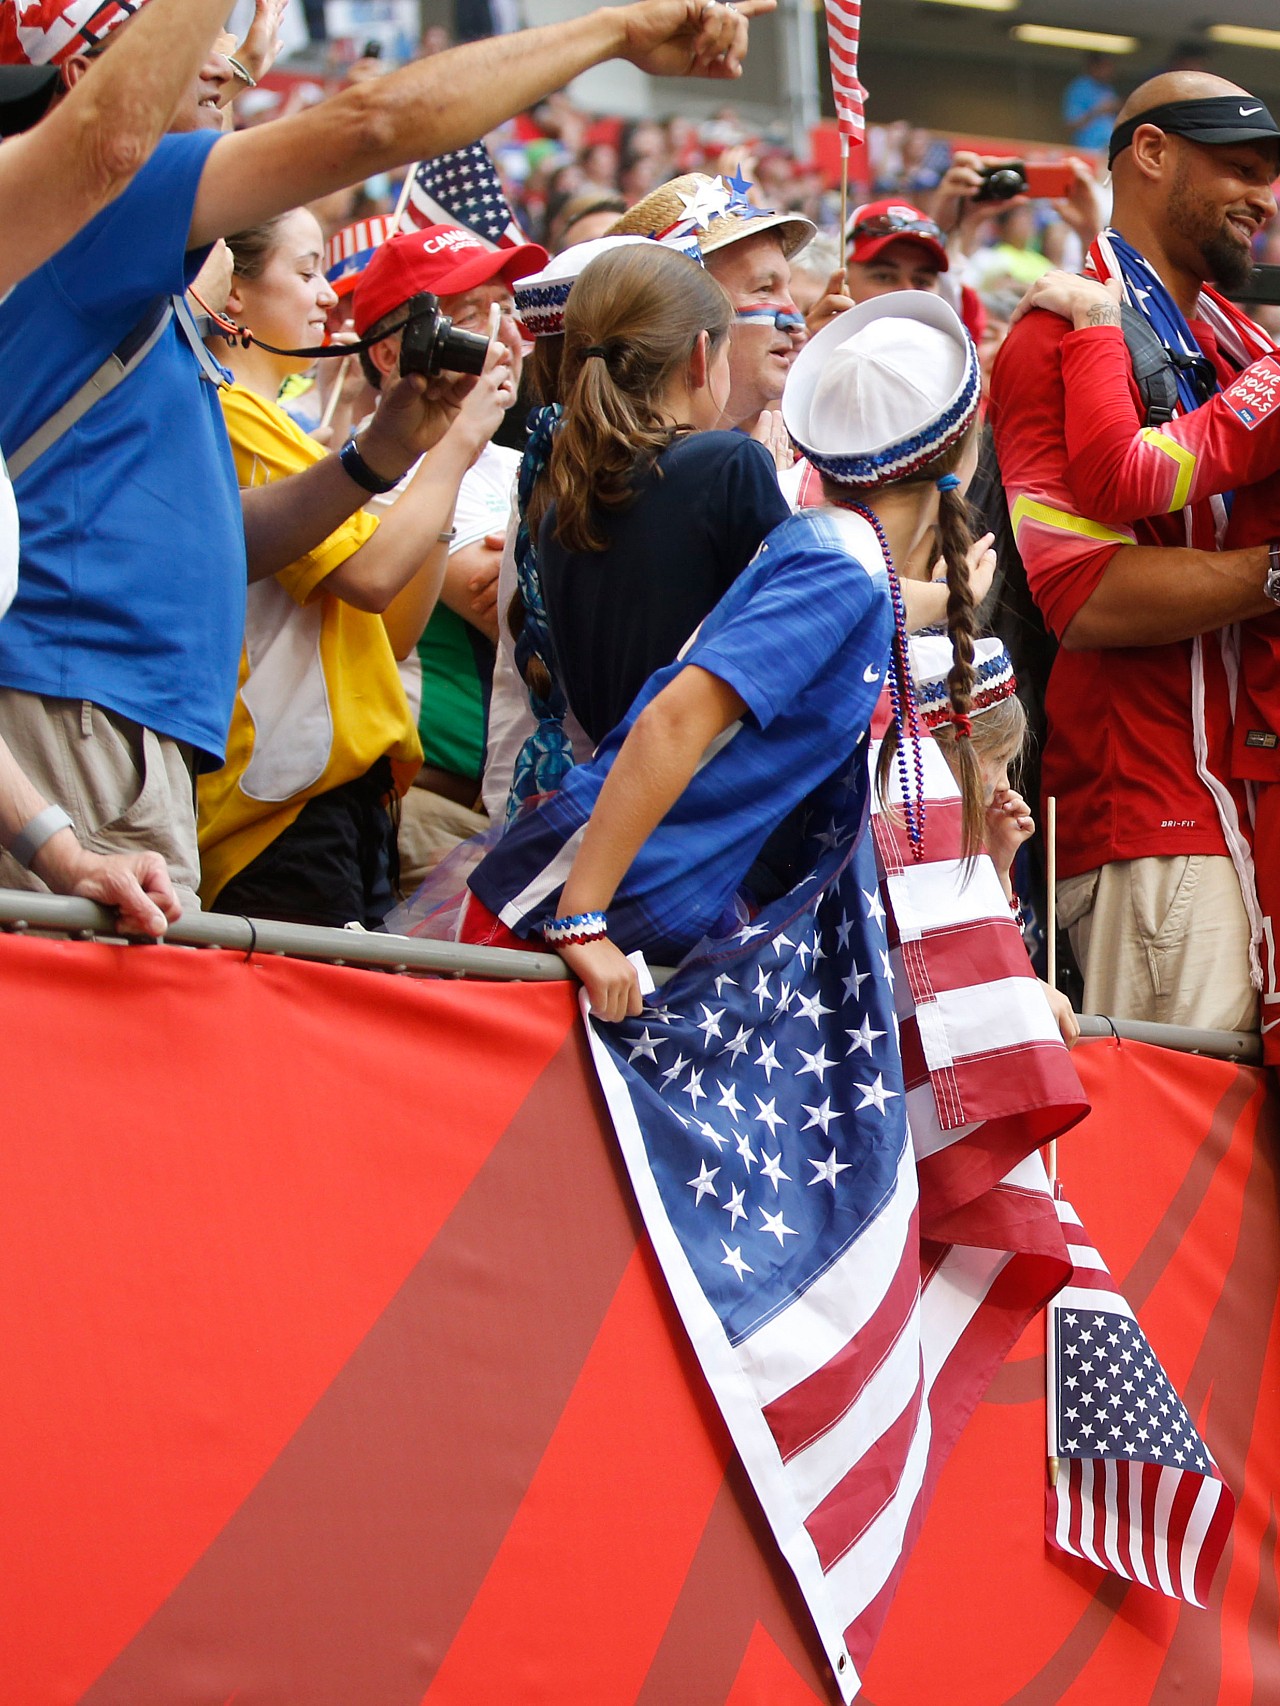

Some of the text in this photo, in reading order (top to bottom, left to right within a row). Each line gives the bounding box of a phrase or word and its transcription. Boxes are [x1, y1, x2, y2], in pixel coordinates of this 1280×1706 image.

[1229, 385, 1272, 412] GOALS
[1240, 374, 1276, 402] YOUR
[1160, 820, 1196, 828] DRI-FIT
